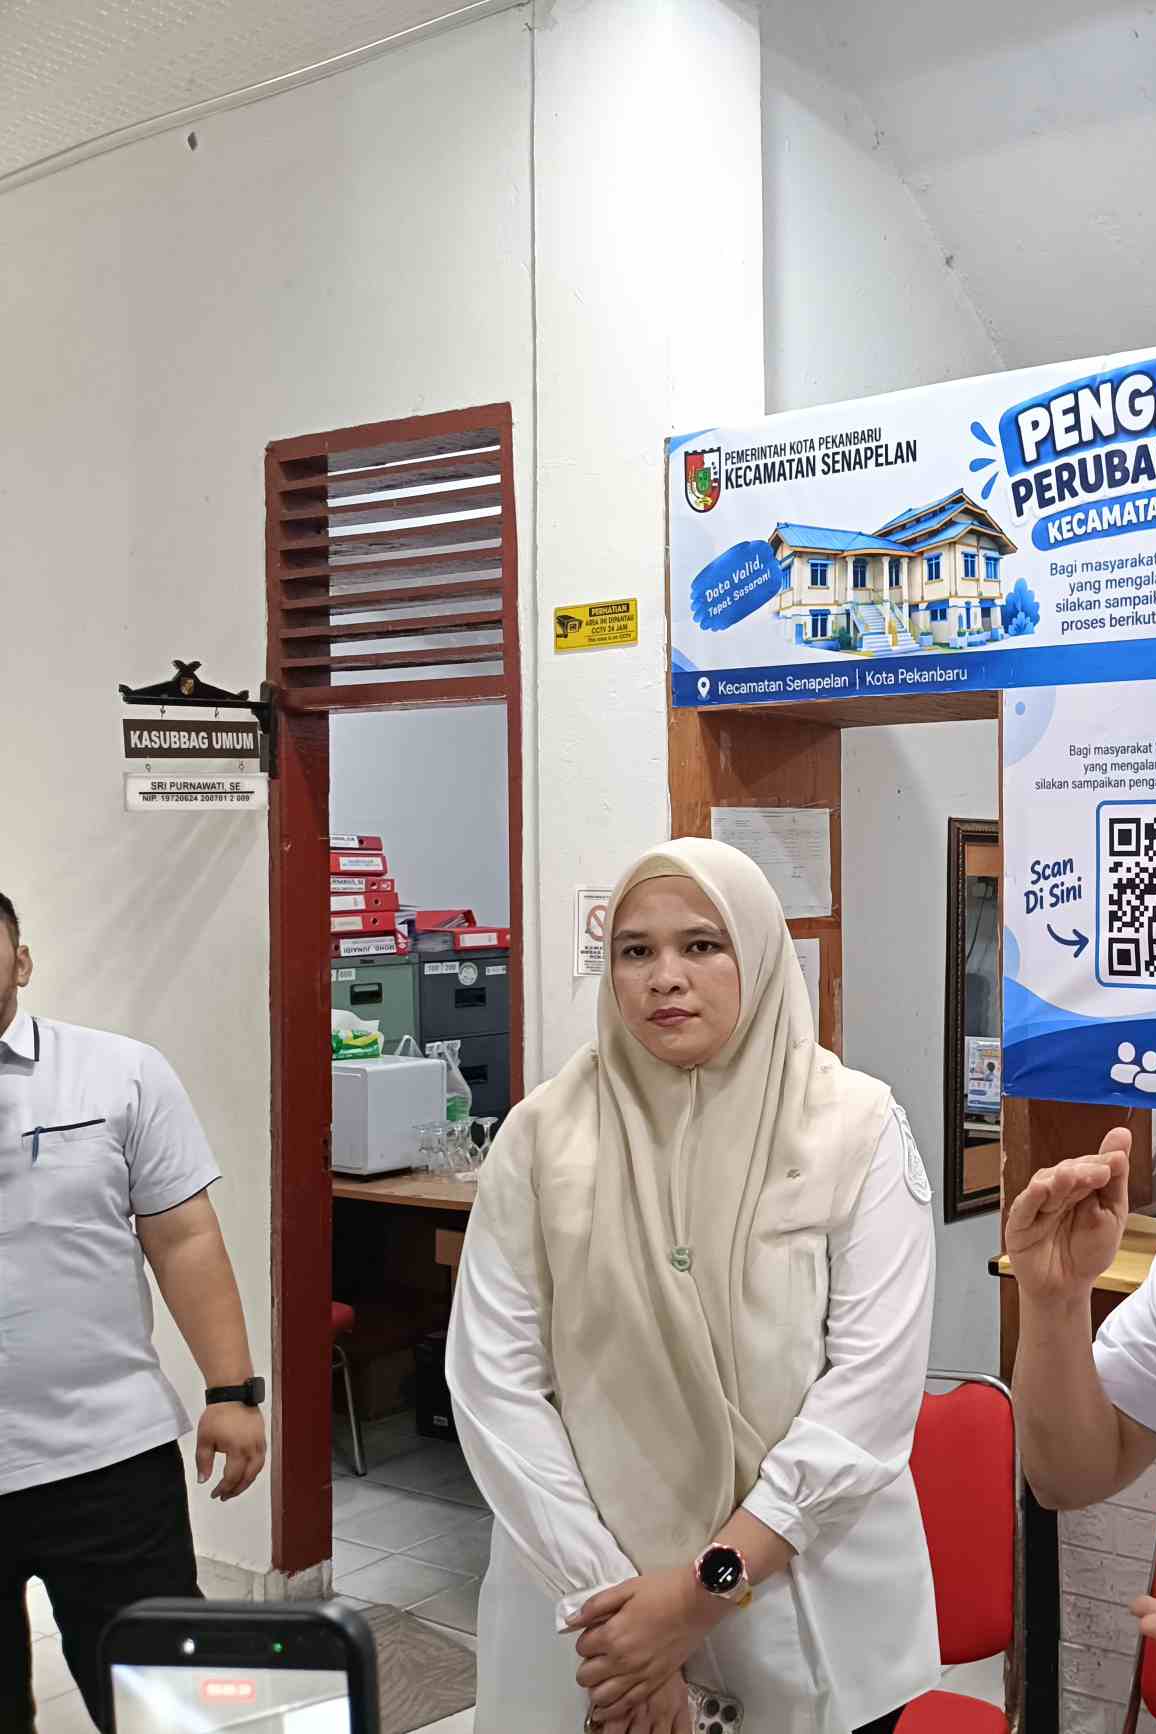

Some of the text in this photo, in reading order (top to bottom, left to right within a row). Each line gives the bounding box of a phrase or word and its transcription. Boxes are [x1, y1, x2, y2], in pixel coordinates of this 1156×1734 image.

[725, 427, 882, 467] PEMERINTAH KOTA PEKANBARU
[725, 439, 917, 490] KECAMATAN SENAPELAN
[706, 554, 764, 602] Data Valid,
[1050, 561, 1077, 578] Bagi
[1069, 579, 1101, 596] yang
[708, 596, 732, 617] Tepat
[1055, 595, 1101, 613] silakan
[1061, 616, 1105, 635] proses
[1110, 608, 1156, 627] berikut
[718, 671, 849, 695] Kecamatan Senapelan
[865, 666, 967, 686] Kota Pekanbaru
[130, 730, 254, 750] KASUBBAG UMUM
[1069, 745, 1090, 758] Bagi
[1094, 742, 1152, 758] masyarakat
[1083, 762, 1107, 775] yang
[150, 781, 167, 791] SRI
[229, 782, 241, 791] SE
[1035, 777, 1069, 790] silakan
[1071, 775, 1126, 792] sampaikan
[1030, 857, 1074, 885] Scan
[1024, 877, 1083, 915] Di Sini
